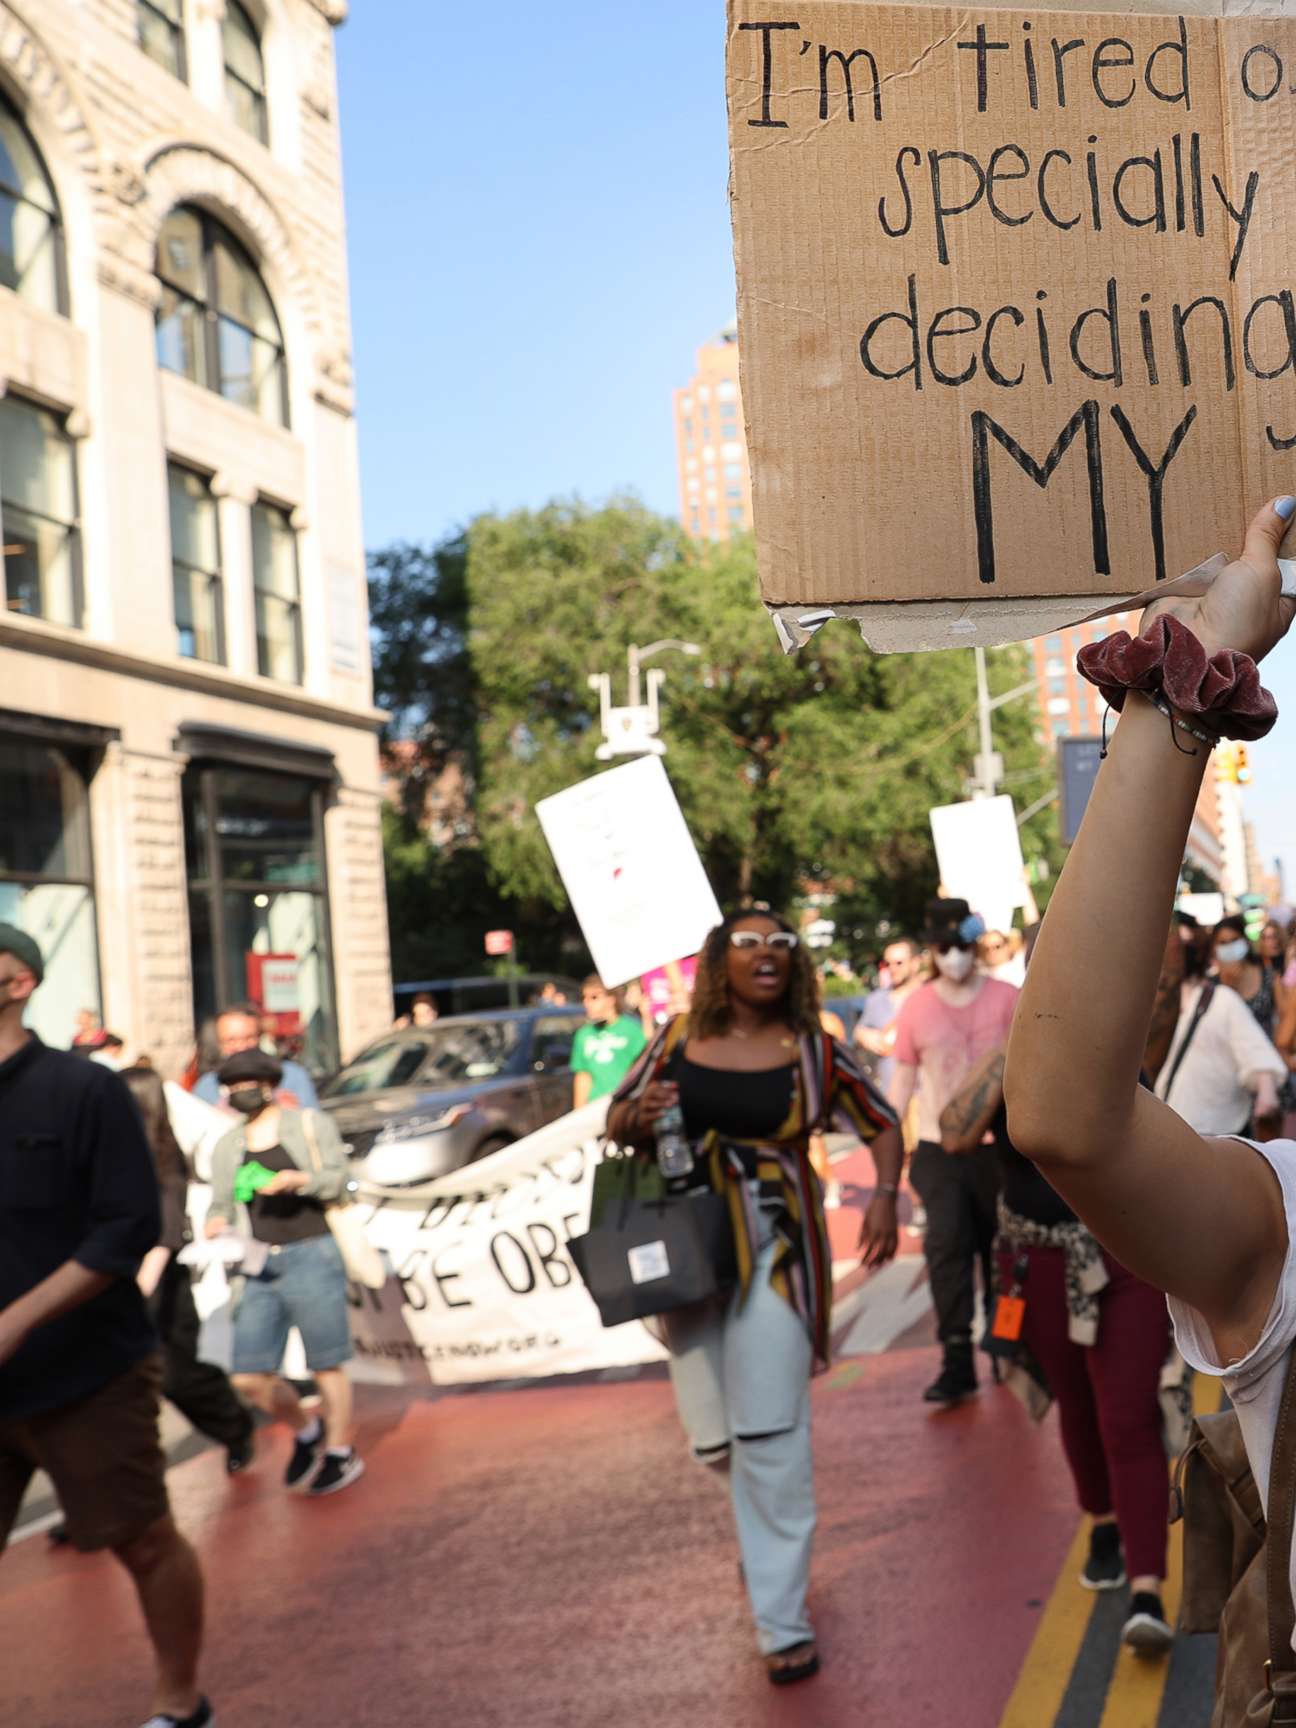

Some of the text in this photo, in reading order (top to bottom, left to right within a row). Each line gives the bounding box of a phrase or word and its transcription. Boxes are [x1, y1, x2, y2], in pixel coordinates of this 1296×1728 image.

[738, 20, 883, 128] I'm
[956, 15, 1192, 112] tired
[877, 131, 1260, 282] specially
[970, 398, 1199, 584] MY
